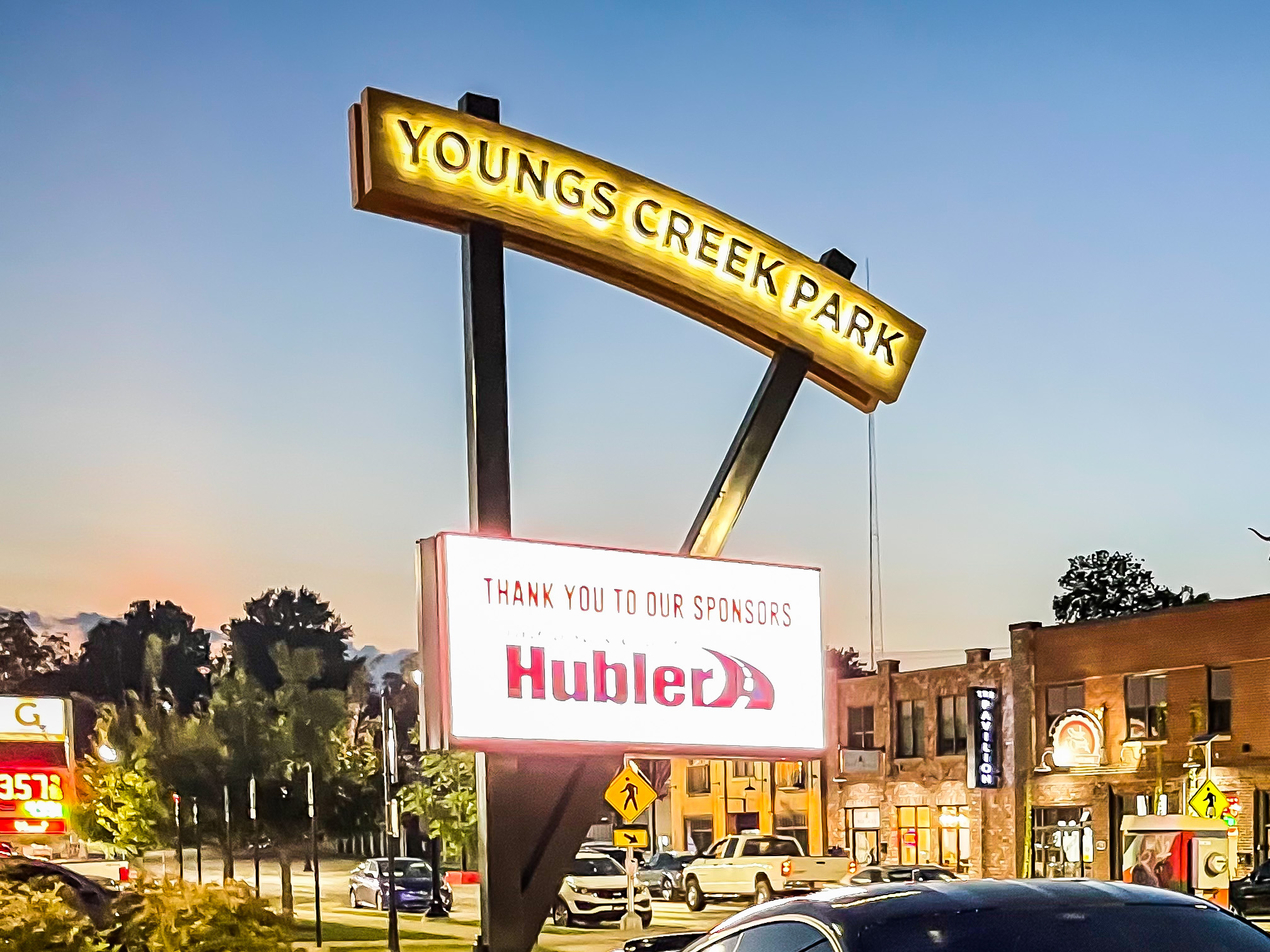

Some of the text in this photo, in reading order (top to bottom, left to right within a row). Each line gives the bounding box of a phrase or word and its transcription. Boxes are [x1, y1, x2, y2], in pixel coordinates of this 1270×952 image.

[397, 118, 905, 367] YOUNGS CREEK PARK
[483, 577, 793, 628] THANK YOU TO OUR SPONSORS
[505, 644, 714, 708] Hubler
[980, 699, 993, 785] PAVILION
